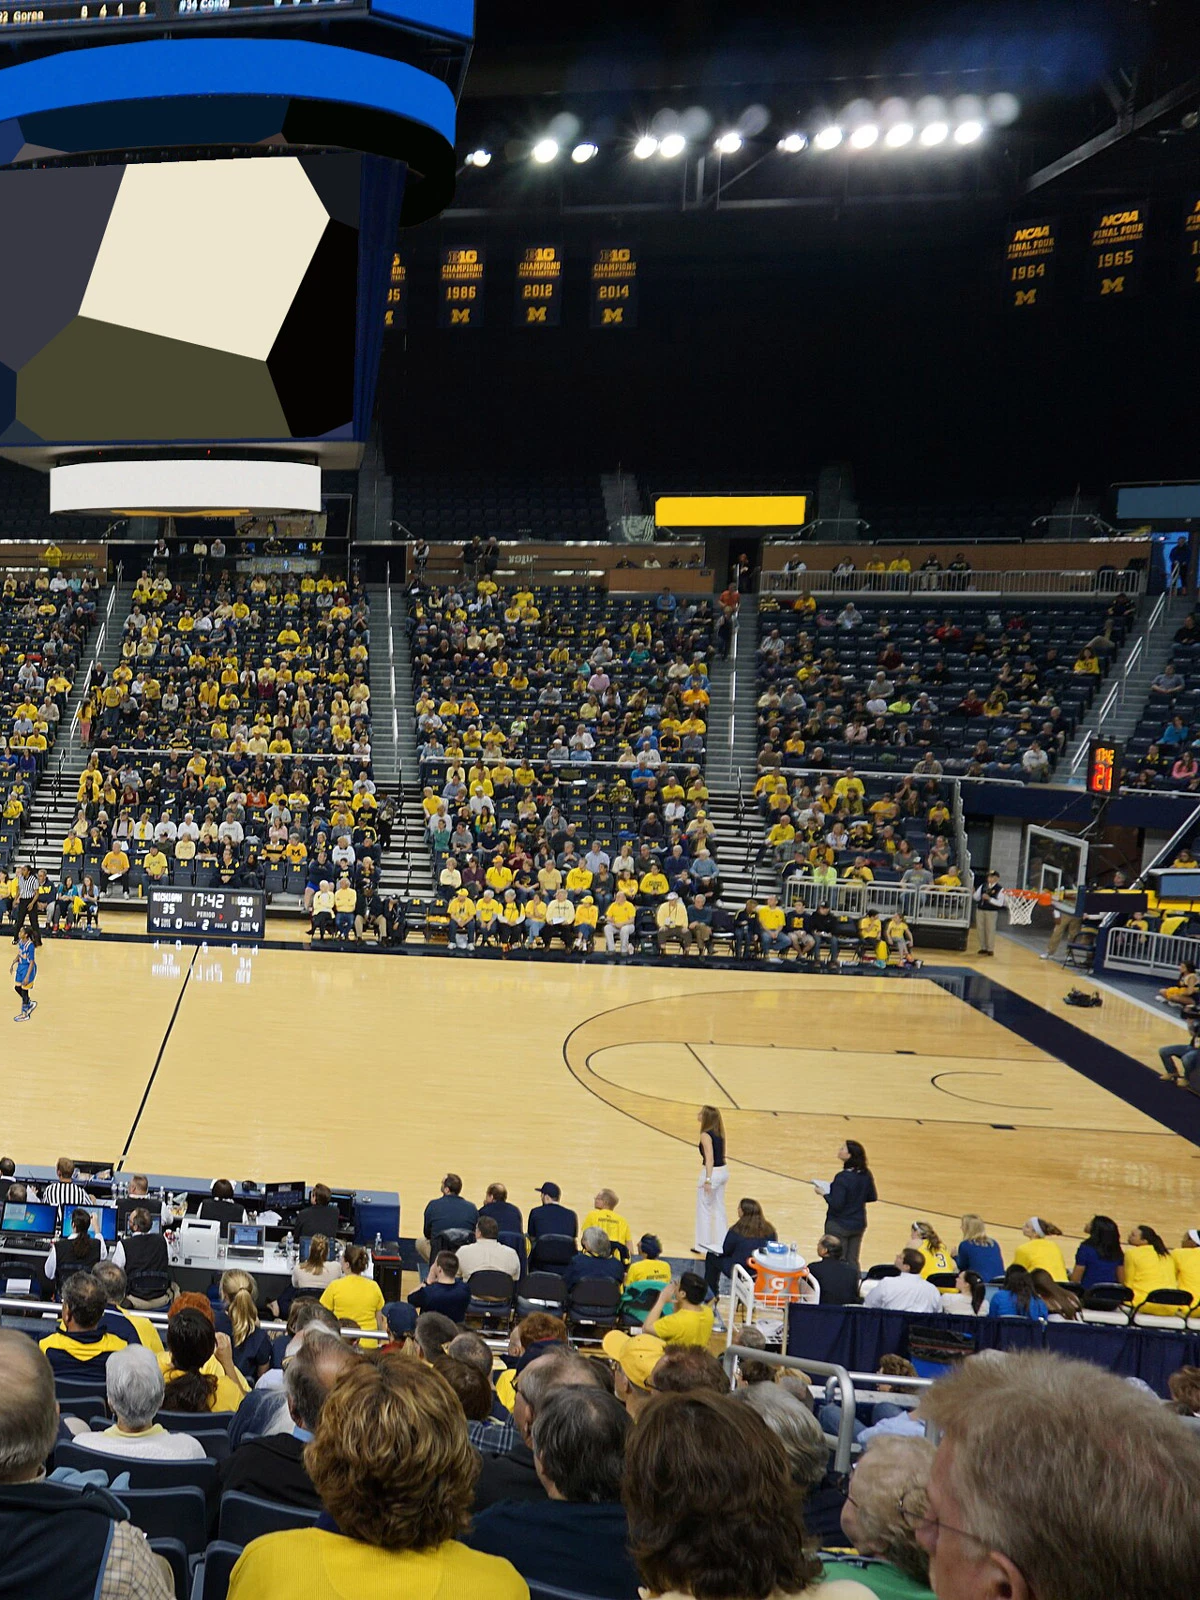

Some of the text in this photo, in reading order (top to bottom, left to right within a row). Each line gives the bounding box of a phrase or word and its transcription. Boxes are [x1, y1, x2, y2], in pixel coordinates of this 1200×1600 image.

[1100, 210, 1140, 228] NCAA
[1014, 225, 1050, 242] NCAA
[1092, 222, 1144, 239] FINAL FOUR
[1008, 236, 1055, 253] FINAL FOUR
[519, 261, 561, 272] CHAMPIONS
[1098, 250, 1134, 269] 1965
[442, 263, 484, 273] CHAMPIONS
[594, 262, 636, 272] CHAMPIONS
[1011, 263, 1046, 282] 1964
[524, 284, 552, 298] 2012
[599, 286, 629, 299] 2014
[1100, 276, 1125, 295] M
[446, 286, 476, 300] 1986
[1014, 288, 1036, 306] M
[450, 308, 470, 323] M
[527, 306, 547, 322] M
[604, 307, 624, 324] M
[1092, 764, 1112, 791] 21
[153, 892, 182, 902] MICHIGAN
[190, 893, 224, 908] 17:42
[237, 896, 254, 906] UCLA
[162, 903, 176, 914] 35
[240, 907, 254, 918] 34
[153, 918, 160, 928] 4
[175, 918, 182, 929] 0
[201, 920, 210, 930] 2
[231, 920, 239, 932] 0
[252, 922, 260, 932] 4
[936, 1252, 946, 1268] 3
[772, 1278, 784, 1290] G
